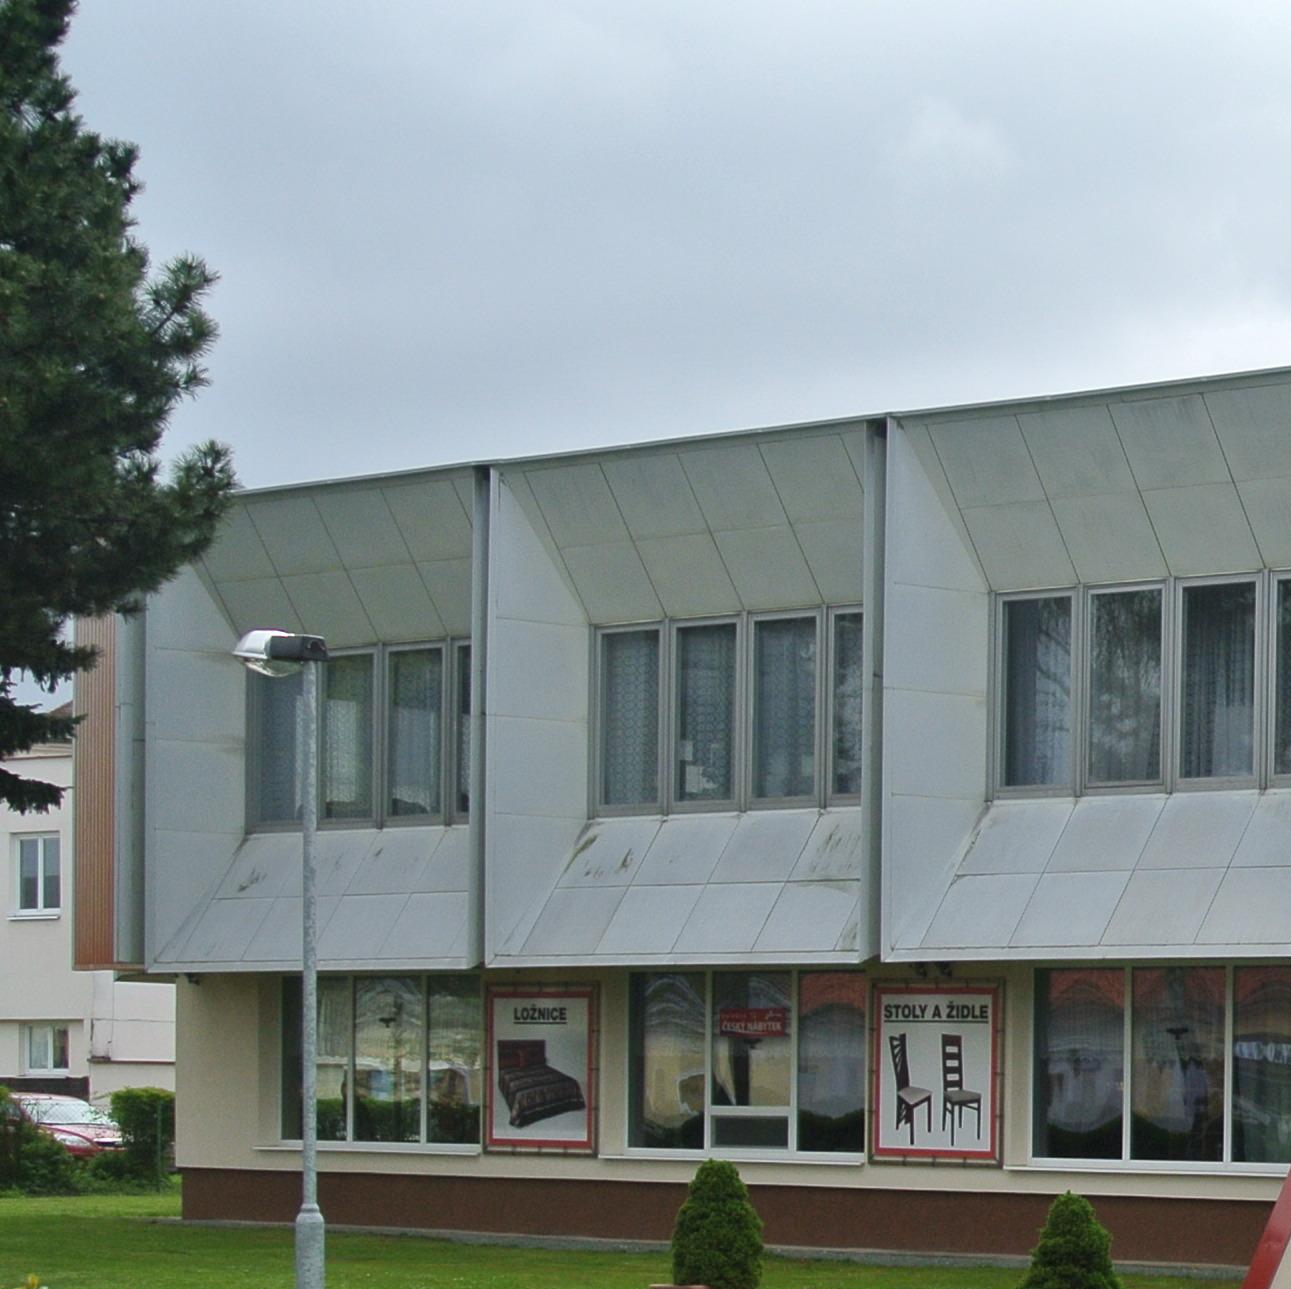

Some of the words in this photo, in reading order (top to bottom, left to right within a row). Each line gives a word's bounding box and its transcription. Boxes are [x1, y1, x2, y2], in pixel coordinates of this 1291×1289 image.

[513, 1003, 567, 1021] LOŽNICE
[884, 1003, 928, 1019] STOLY
[931, 1004, 942, 1018] A
[946, 1001, 989, 1019] ŽIDLE
